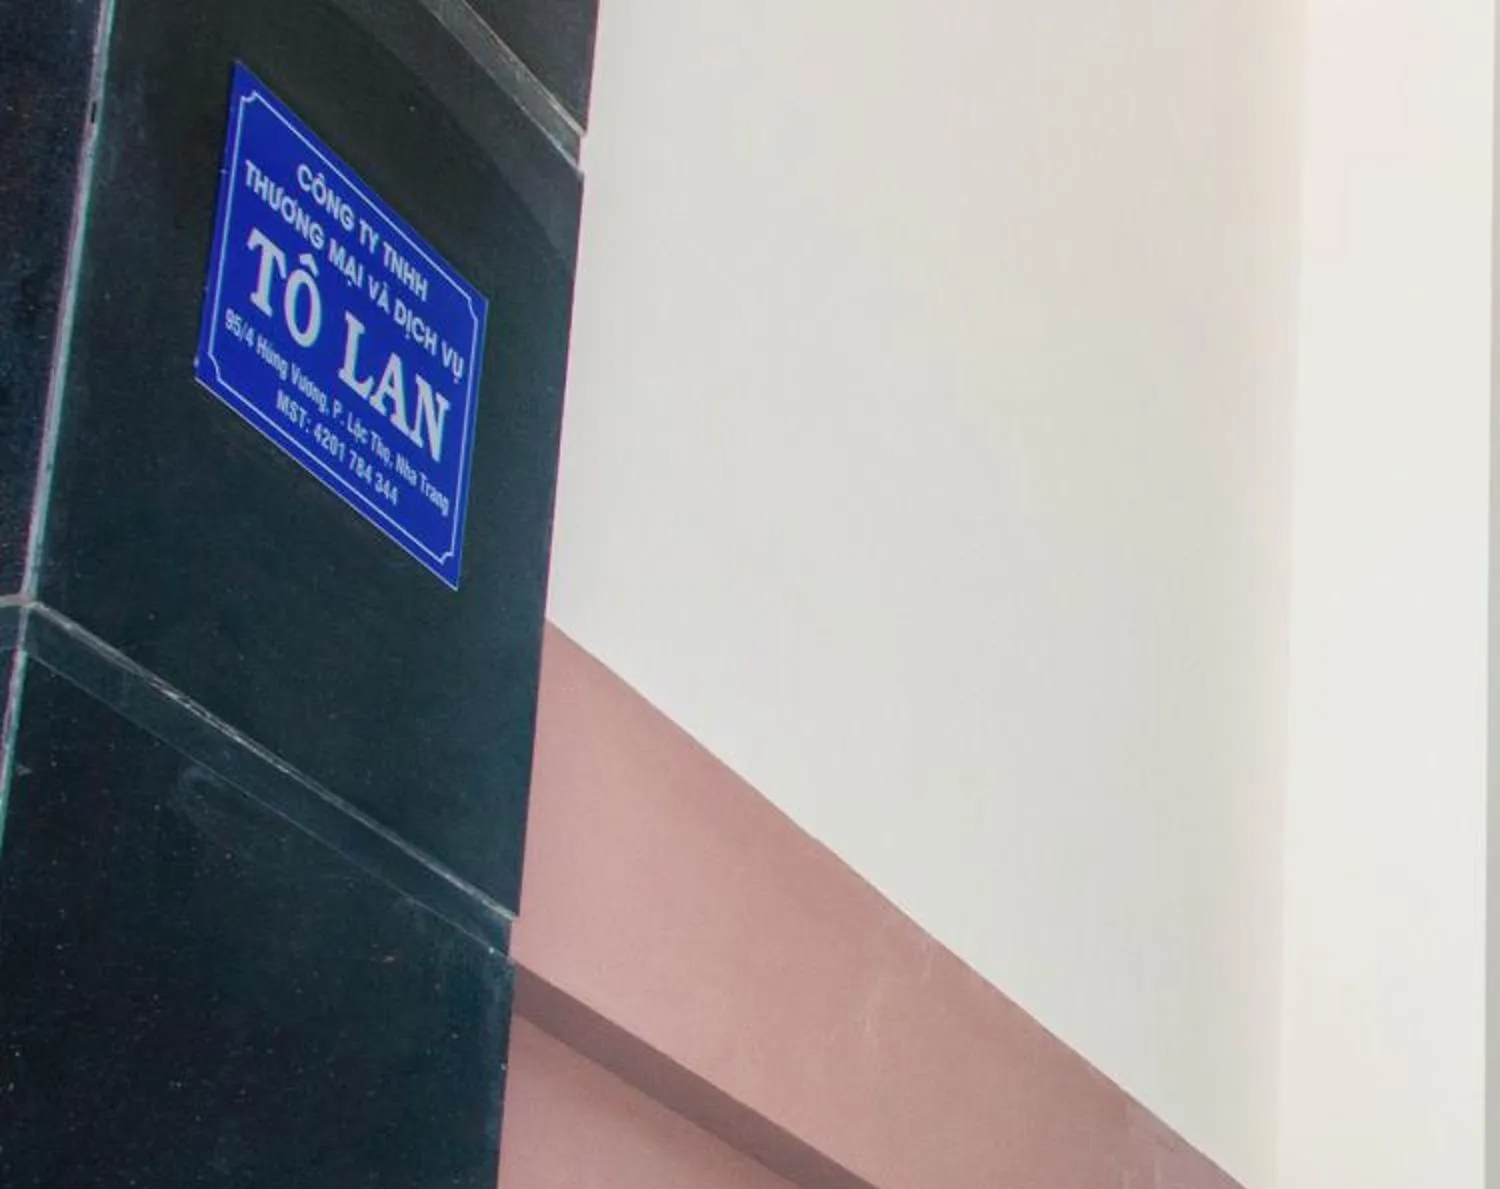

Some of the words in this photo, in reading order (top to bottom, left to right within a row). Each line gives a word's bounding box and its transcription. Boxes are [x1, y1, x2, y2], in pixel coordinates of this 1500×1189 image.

[244, 159, 325, 250] THƯƠNG
[328, 238, 364, 288] MẠI
[368, 274, 391, 316] VÀ
[393, 297, 438, 357] DỊCH
[441, 340, 465, 385] VỤ
[297, 164, 355, 231] CÔNG
[359, 218, 380, 255] TY
[383, 241, 429, 303] TNHH
[225, 308, 255, 348] 95/4
[395, 452, 418, 488] Nha
[419, 471, 449, 518] Trang
[246, 226, 322, 348] TÔ
[337, 309, 451, 463] LAN
[276, 388, 312, 433] MST:
[313, 422, 346, 463] 4201
[349, 449, 374, 484] 784
[374, 471, 399, 507] 344
